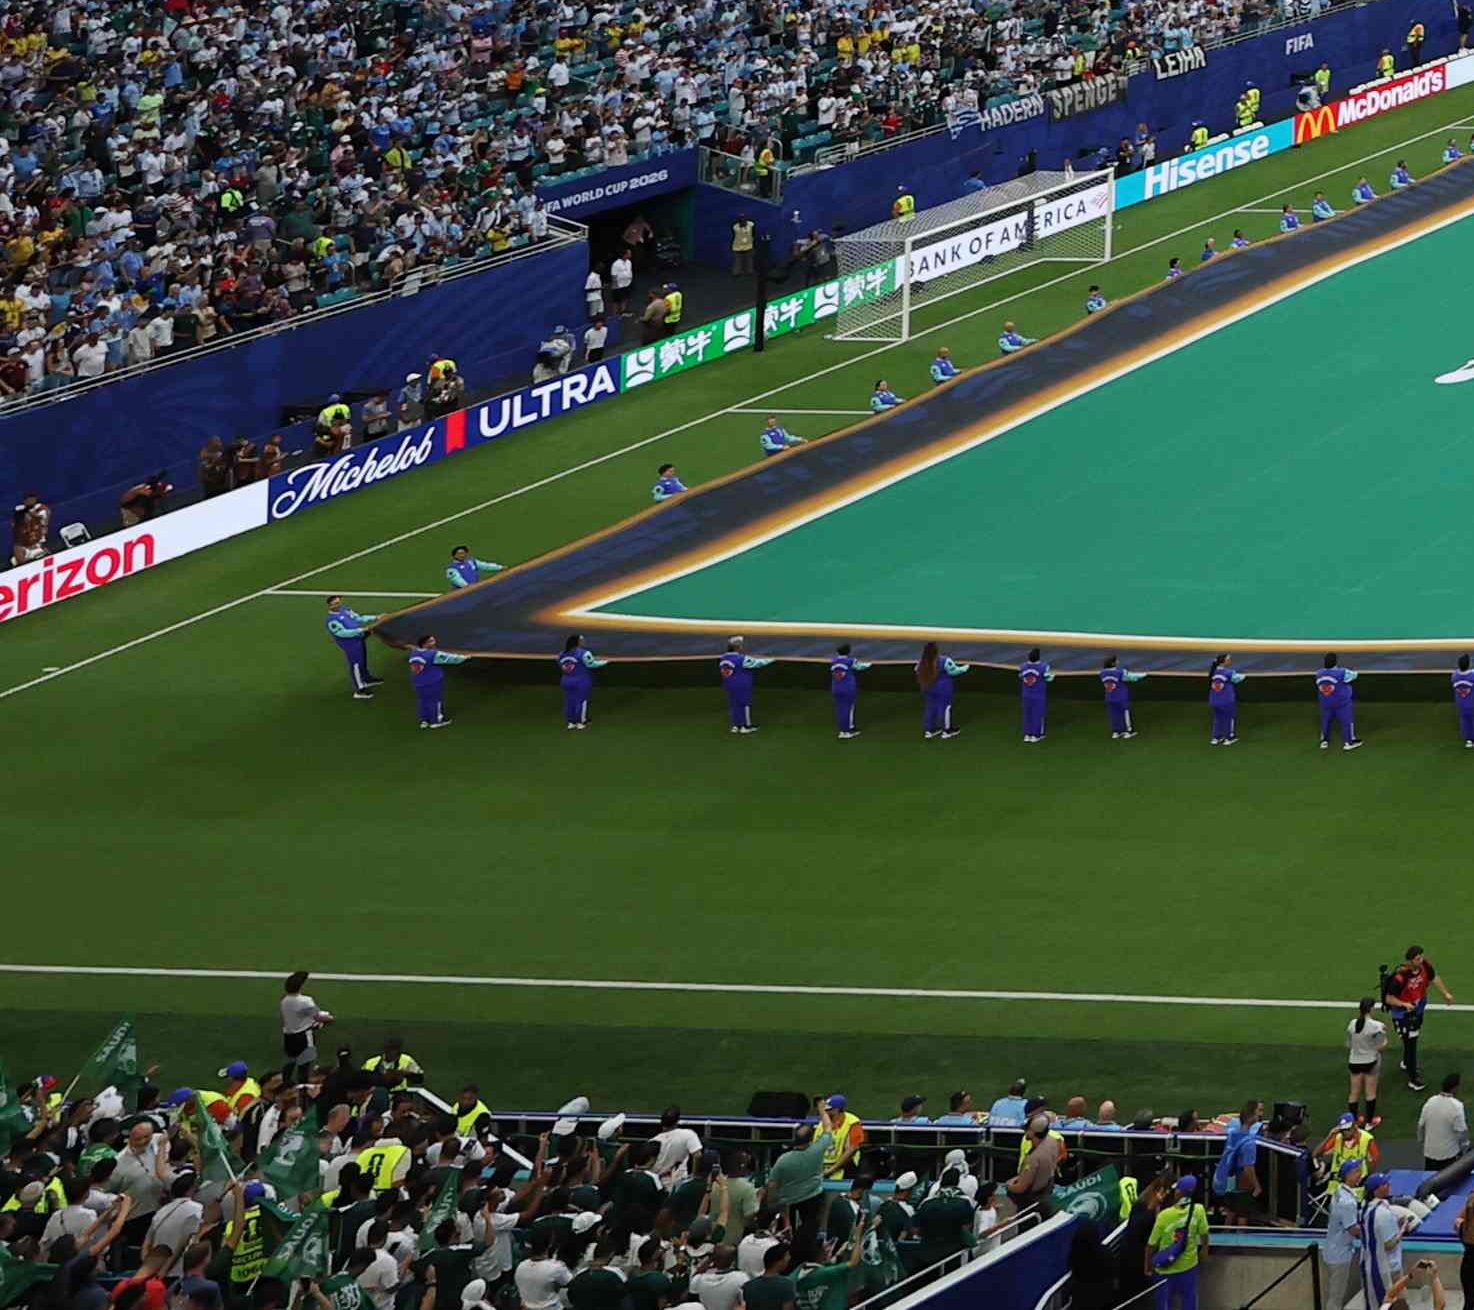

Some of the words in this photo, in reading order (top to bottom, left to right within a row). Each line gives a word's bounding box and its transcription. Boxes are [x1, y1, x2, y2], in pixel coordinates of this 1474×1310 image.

[1285, 33, 1315, 55] FIFA
[1338, 64, 1445, 127] McDonald's
[561, 187, 604, 208] WORLD
[605, 180, 629, 196] CUP
[629, 169, 668, 190] 2026
[1144, 135, 1270, 200] Hisense
[969, 232, 994, 255] OF
[272, 425, 436, 520] Michelob
[478, 364, 616, 438] ULTRA
